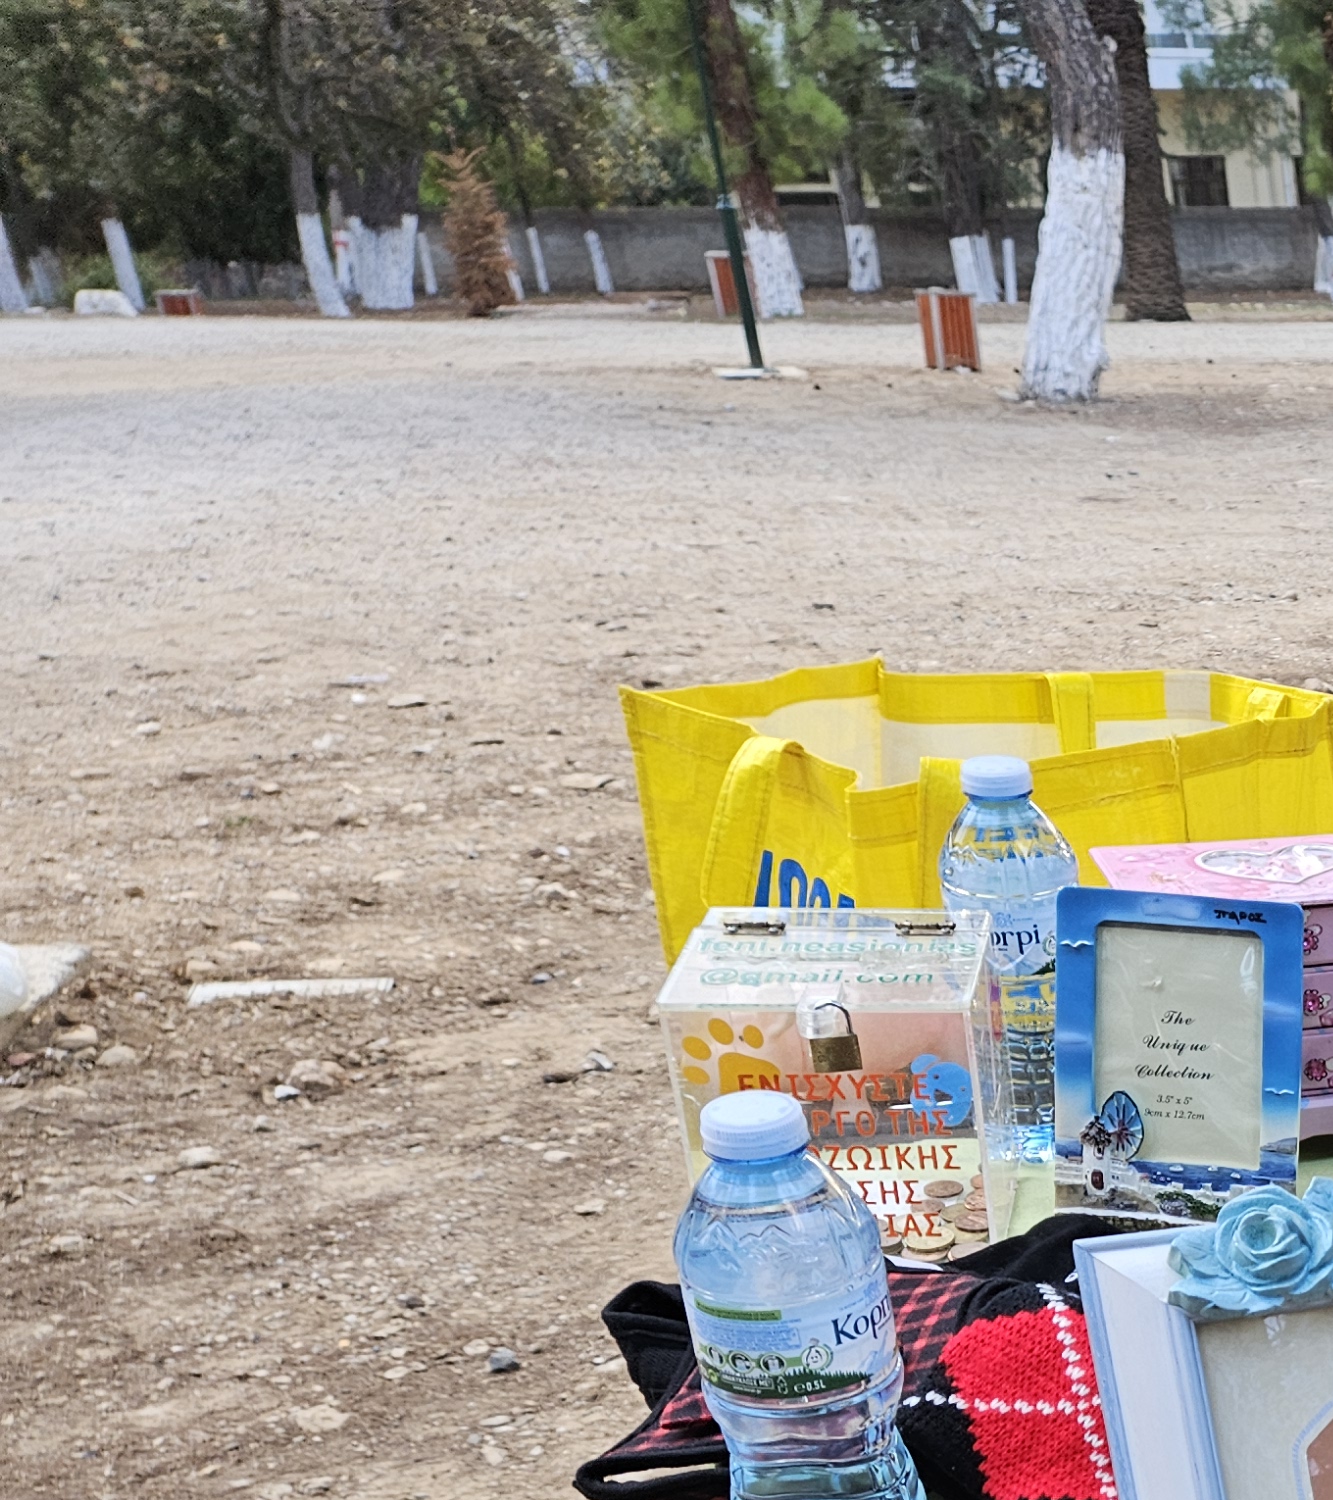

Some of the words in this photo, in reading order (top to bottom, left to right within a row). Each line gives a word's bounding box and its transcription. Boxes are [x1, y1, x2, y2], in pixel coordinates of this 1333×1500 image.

[699, 936, 977, 956] feni.neasionias
[990, 924, 1041, 955] orpi
[699, 966, 935, 987] @gmail.com
[1160, 1010, 1196, 1026] The
[1142, 1034, 1211, 1056] Unique
[1134, 1064, 1214, 1081] Collection
[737, 1074, 931, 1100] ΕΝΙΣΧΥΣΤΕ
[810, 1109, 877, 1136] ΡΓΟ
[884, 1109, 953, 1136] ΤΗΣ
[1144, 1108, 1164, 1118] 9cm
[1173, 1110, 1205, 1121] 12.7cm
[875, 1211, 942, 1238] ΙΑΣ
[806, 1380, 826, 1391] 0.5L
